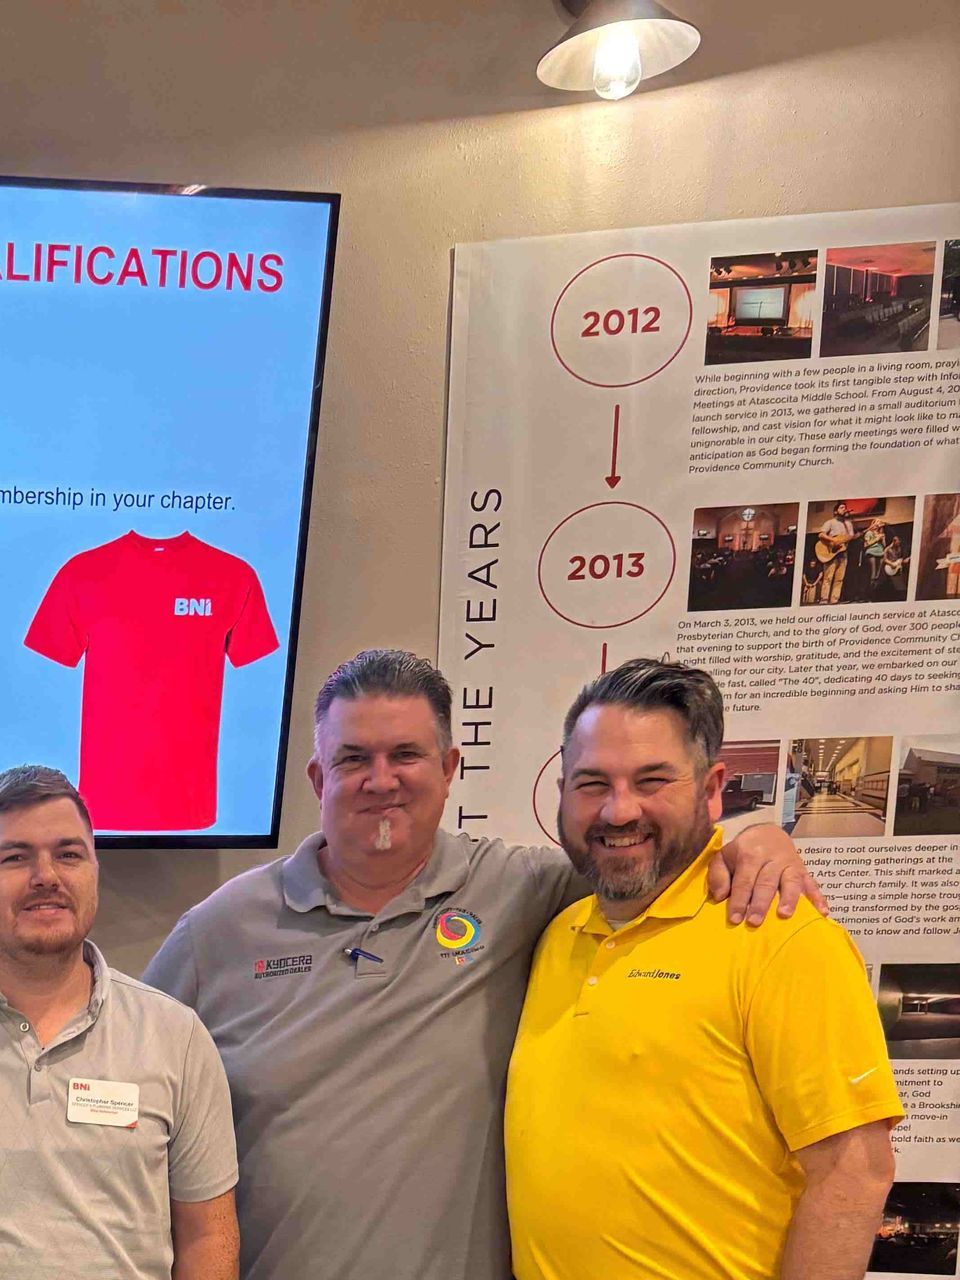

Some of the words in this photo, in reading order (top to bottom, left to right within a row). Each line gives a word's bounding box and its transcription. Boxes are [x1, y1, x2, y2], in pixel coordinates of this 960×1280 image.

[581, 306, 661, 338] 2012
[694, 387, 737, 397] direction,
[739, 384, 792, 394] Providence
[794, 380, 816, 390] took
[818, 380, 830, 388] its
[832, 378, 850, 387] first
[853, 376, 892, 387] tangible
[893, 375, 915, 384] step
[917, 373, 938, 384] with
[692, 424, 740, 435] fellowship,
[742, 422, 761, 432] and
[762, 422, 782, 431] cast
[784, 420, 811, 430] vision
[814, 417, 827, 430] for
[830, 417, 853, 426] what
[855, 416, 862, 425] it
[864, 414, 892, 425] might
[895, 413, 915, 425] look
[917, 412, 934, 421] like
[936, 411, 947, 420] to
[688, 463, 740, 475] Providence
[742, 460, 797, 470] Community
[798, 457, 834, 467] Church.
[91, 488, 106, 506] in
[113, 494, 155, 512] your
[161, 491, 235, 513] chapter.
[464, 488, 502, 660] YEARS
[567, 552, 645, 580] 2013
[677, 631, 734, 642] Presbyterian
[736, 630, 771, 639] Church,
[773, 628, 791, 637] and
[805, 627, 820, 636] the
[822, 625, 847, 637] glory
[849, 624, 859, 634] of
[862, 624, 884, 635] God,
[885, 623, 907, 632] over
[909, 622, 929, 631] 300
[728, 680, 747, 688] fast,
[749, 679, 777, 689] called
[778, 678, 800, 686] "The
[802, 677, 822, 687] 40",
[824, 675, 873, 685] dedicating
[875, 674, 888, 682] 40
[889, 673, 912, 682] days
[915, 673, 925, 681] to
[460, 686, 493, 779] THE
[816, 870, 837, 881] Arts
[838, 869, 871, 879] Center.
[874, 867, 894, 876] This
[895, 868, 916, 876] shift
[918, 868, 954, 878] marked
[827, 882, 844, 892] our
[844, 880, 876, 891] church
[877, 880, 908, 890] family.
[912, 880, 918, 888] It
[941, 878, 960, 888] also
[254, 968, 289, 979] AUTHORIZED
[290, 966, 312, 975] DEALER
[76, 1096, 109, 1105] Christopher
[891, 1134, 912, 1145] bold
[912, 1135, 935, 1143] faith
